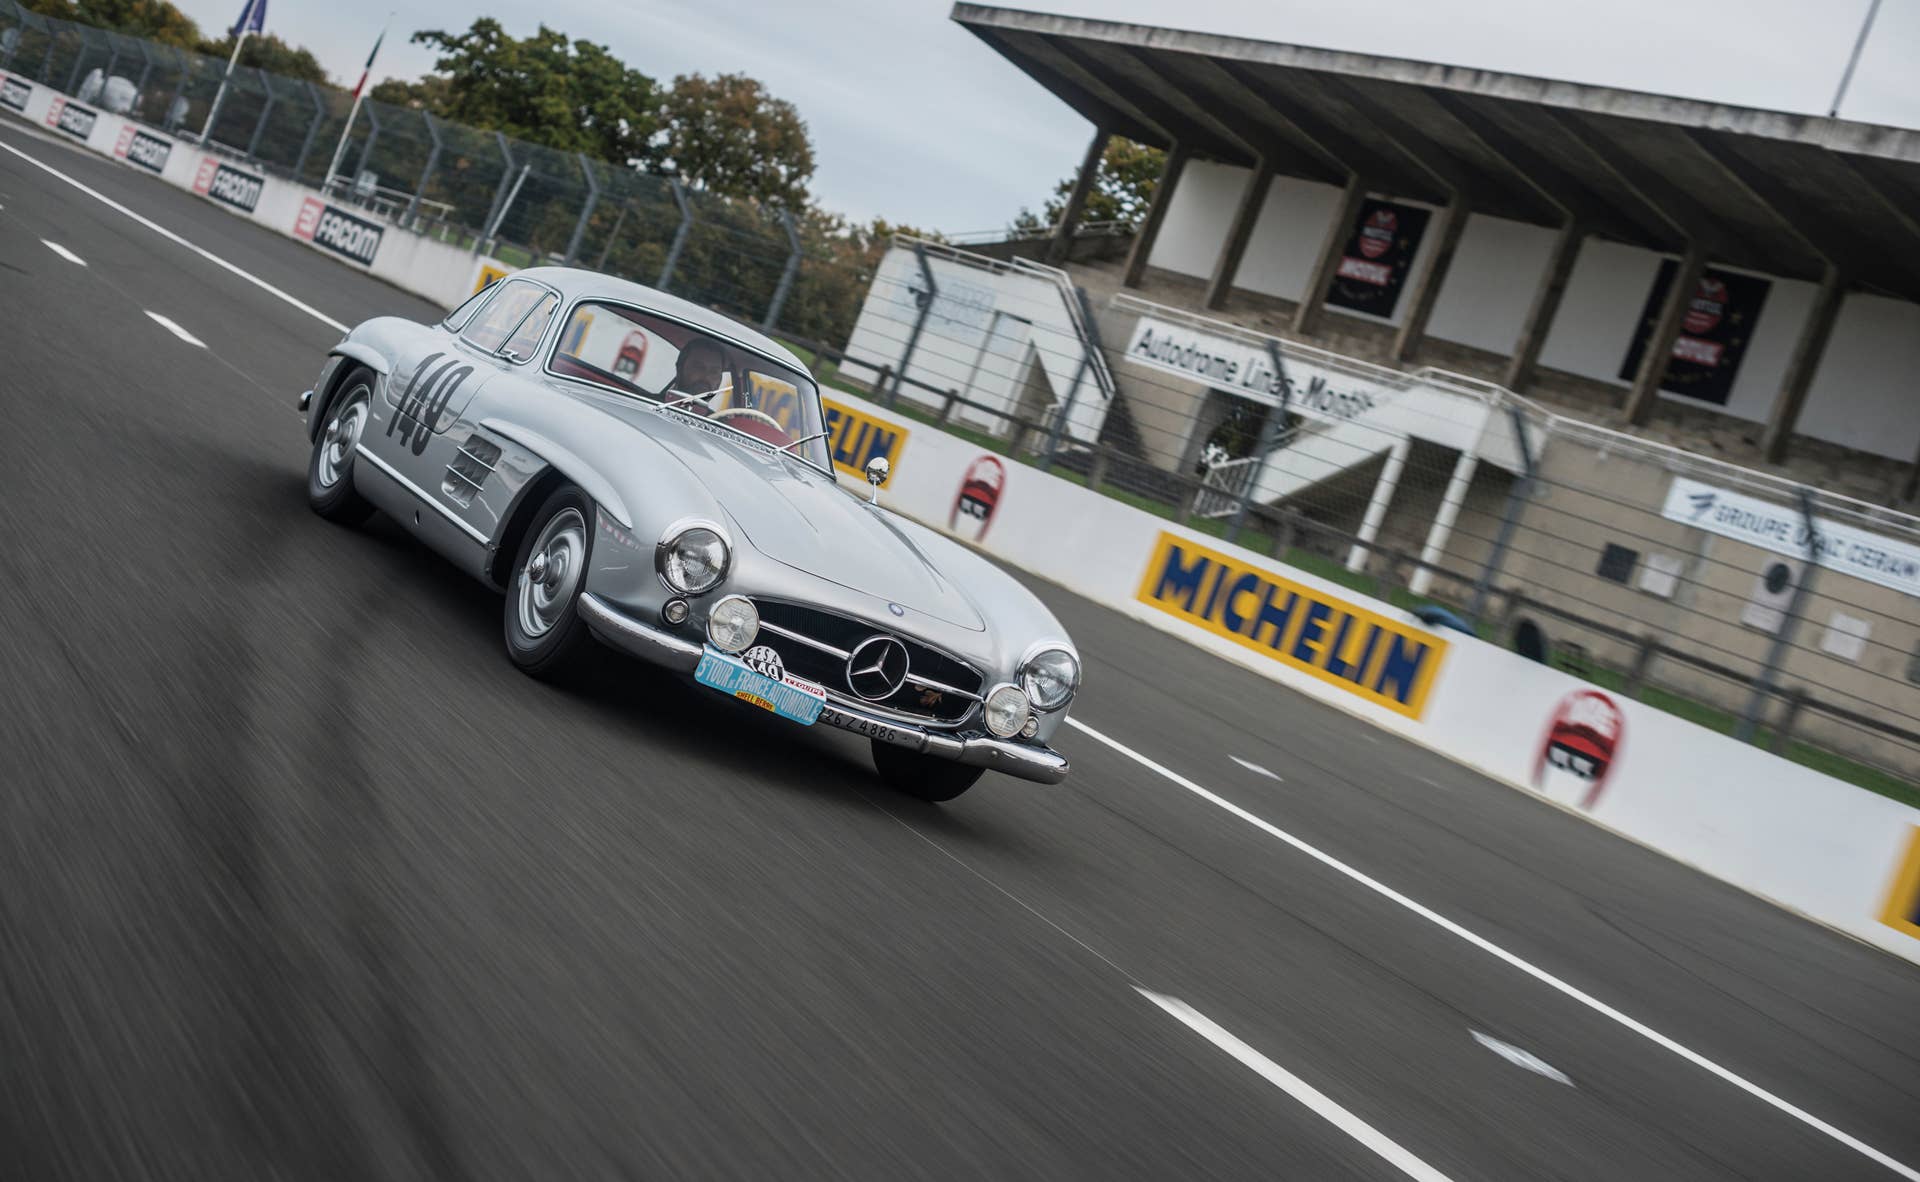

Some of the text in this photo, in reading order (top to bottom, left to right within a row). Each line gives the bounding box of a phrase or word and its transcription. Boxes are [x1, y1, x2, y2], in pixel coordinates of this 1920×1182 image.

[211, 168, 260, 208] FACOM
[316, 211, 380, 261] FACOM
[1134, 328, 1238, 382] Autodrome
[1714, 504, 1791, 542] GROUPE
[1153, 545, 1431, 706] MICHELIN
[747, 659, 780, 681] 149
[707, 660, 734, 687] TOUR
[735, 671, 771, 698] FRANCE
[768, 684, 822, 722] AUTOMOBILE
[736, 691, 754, 703] SHELL
[846, 717, 857, 729] Z
[859, 720, 897, 741] 4886
